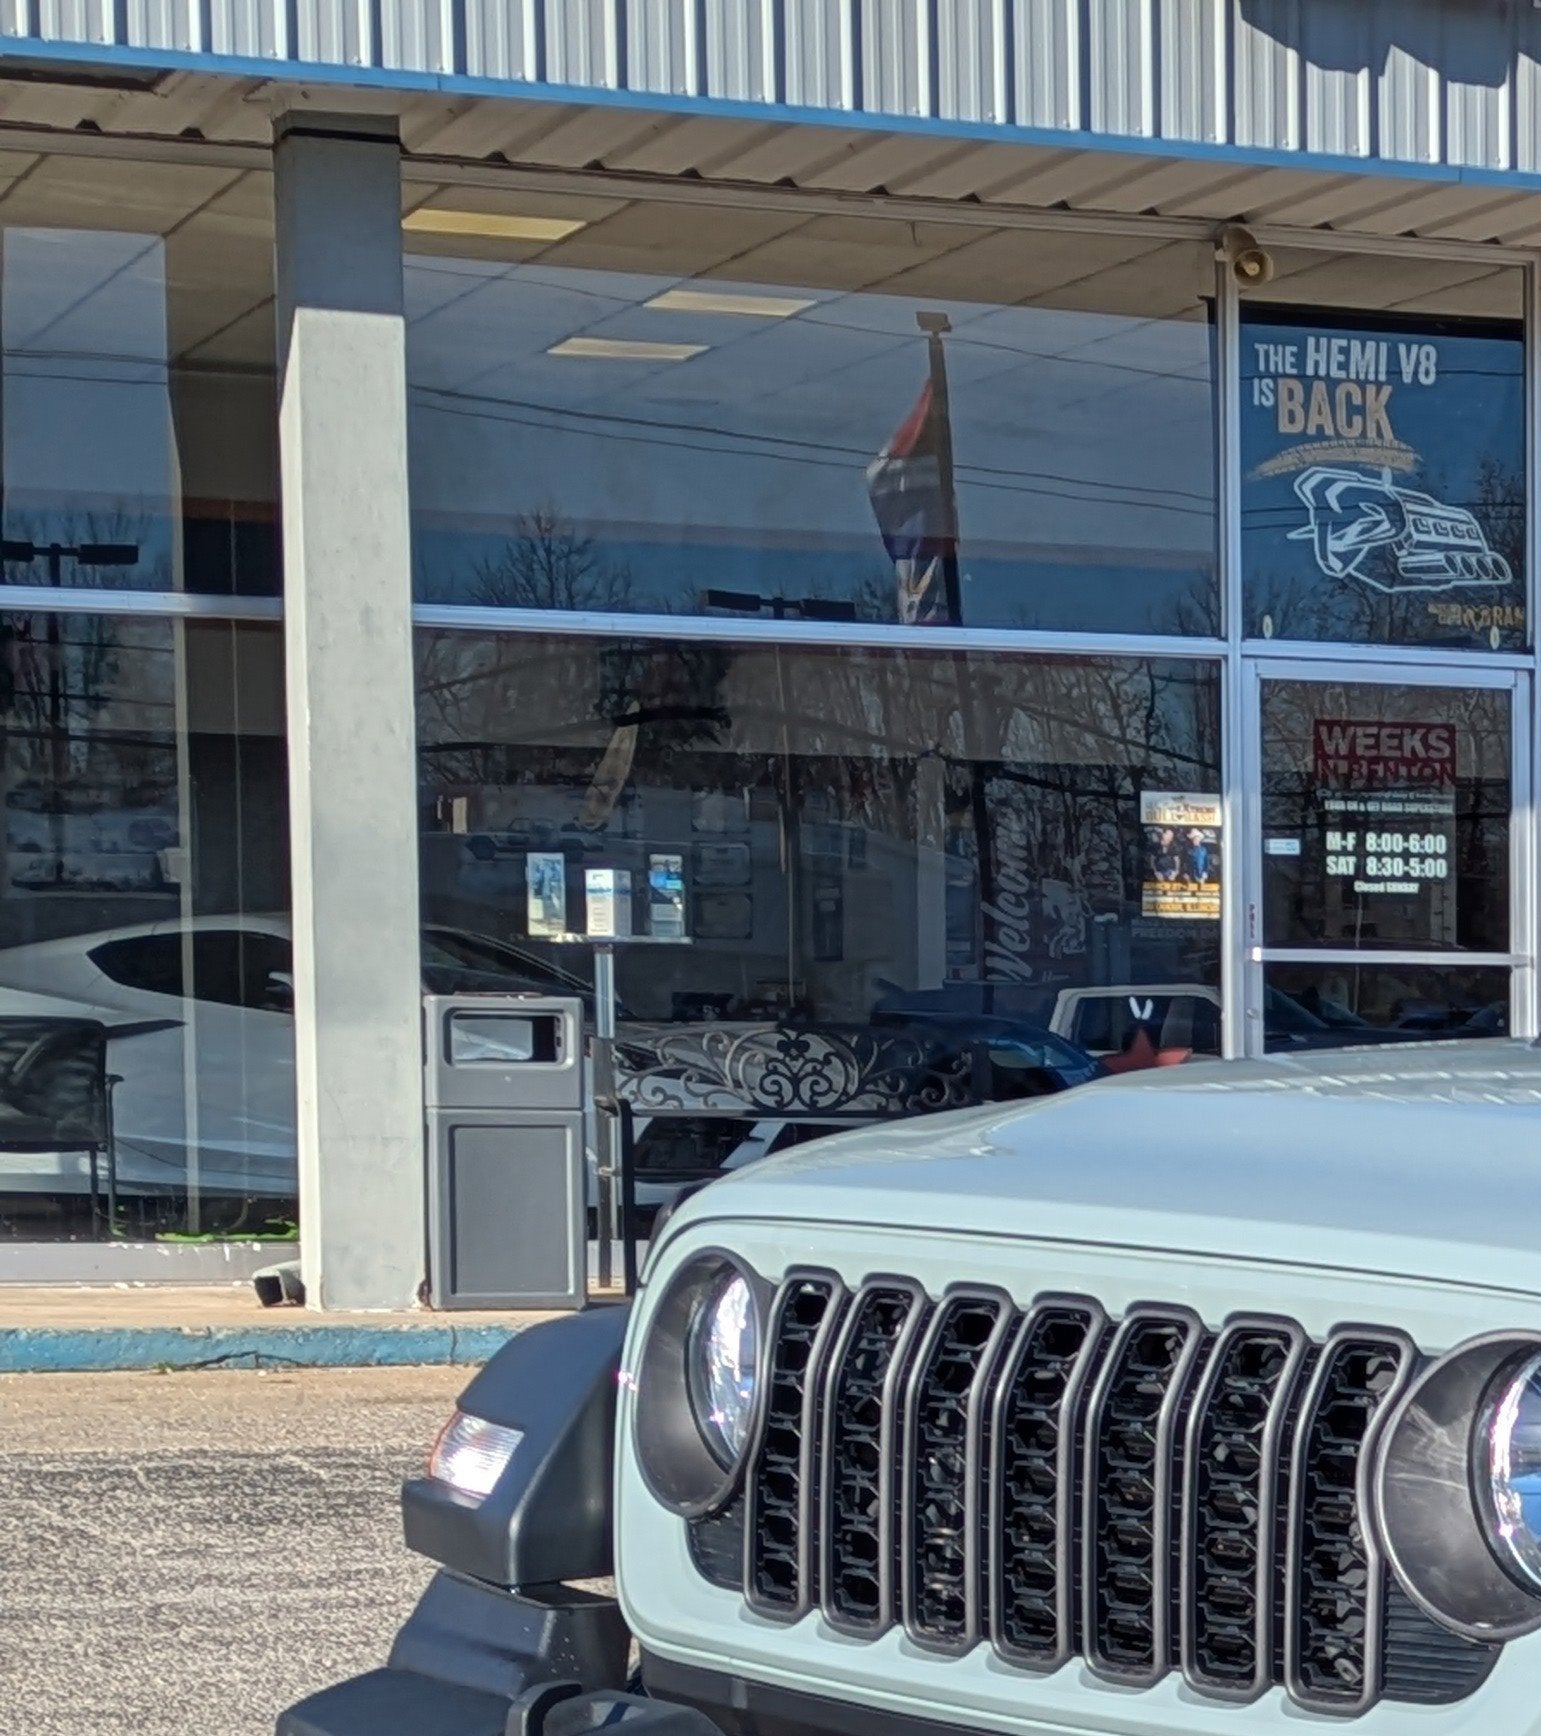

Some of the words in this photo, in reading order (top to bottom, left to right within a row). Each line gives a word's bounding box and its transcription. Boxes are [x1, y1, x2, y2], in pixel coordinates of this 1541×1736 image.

[1254, 343, 1298, 375] THE
[1306, 336, 1388, 382] HEMI
[1398, 343, 1437, 386] V8
[1253, 378, 1275, 407] IS
[1277, 378, 1394, 439] BACK
[1319, 726, 1451, 758] WEEKS
[1326, 832, 1356, 851] M-F
[1366, 832, 1447, 854] 8:00-6:00
[1326, 855, 1357, 875] SAT
[1366, 856, 1448, 878] 8:30-5:00
